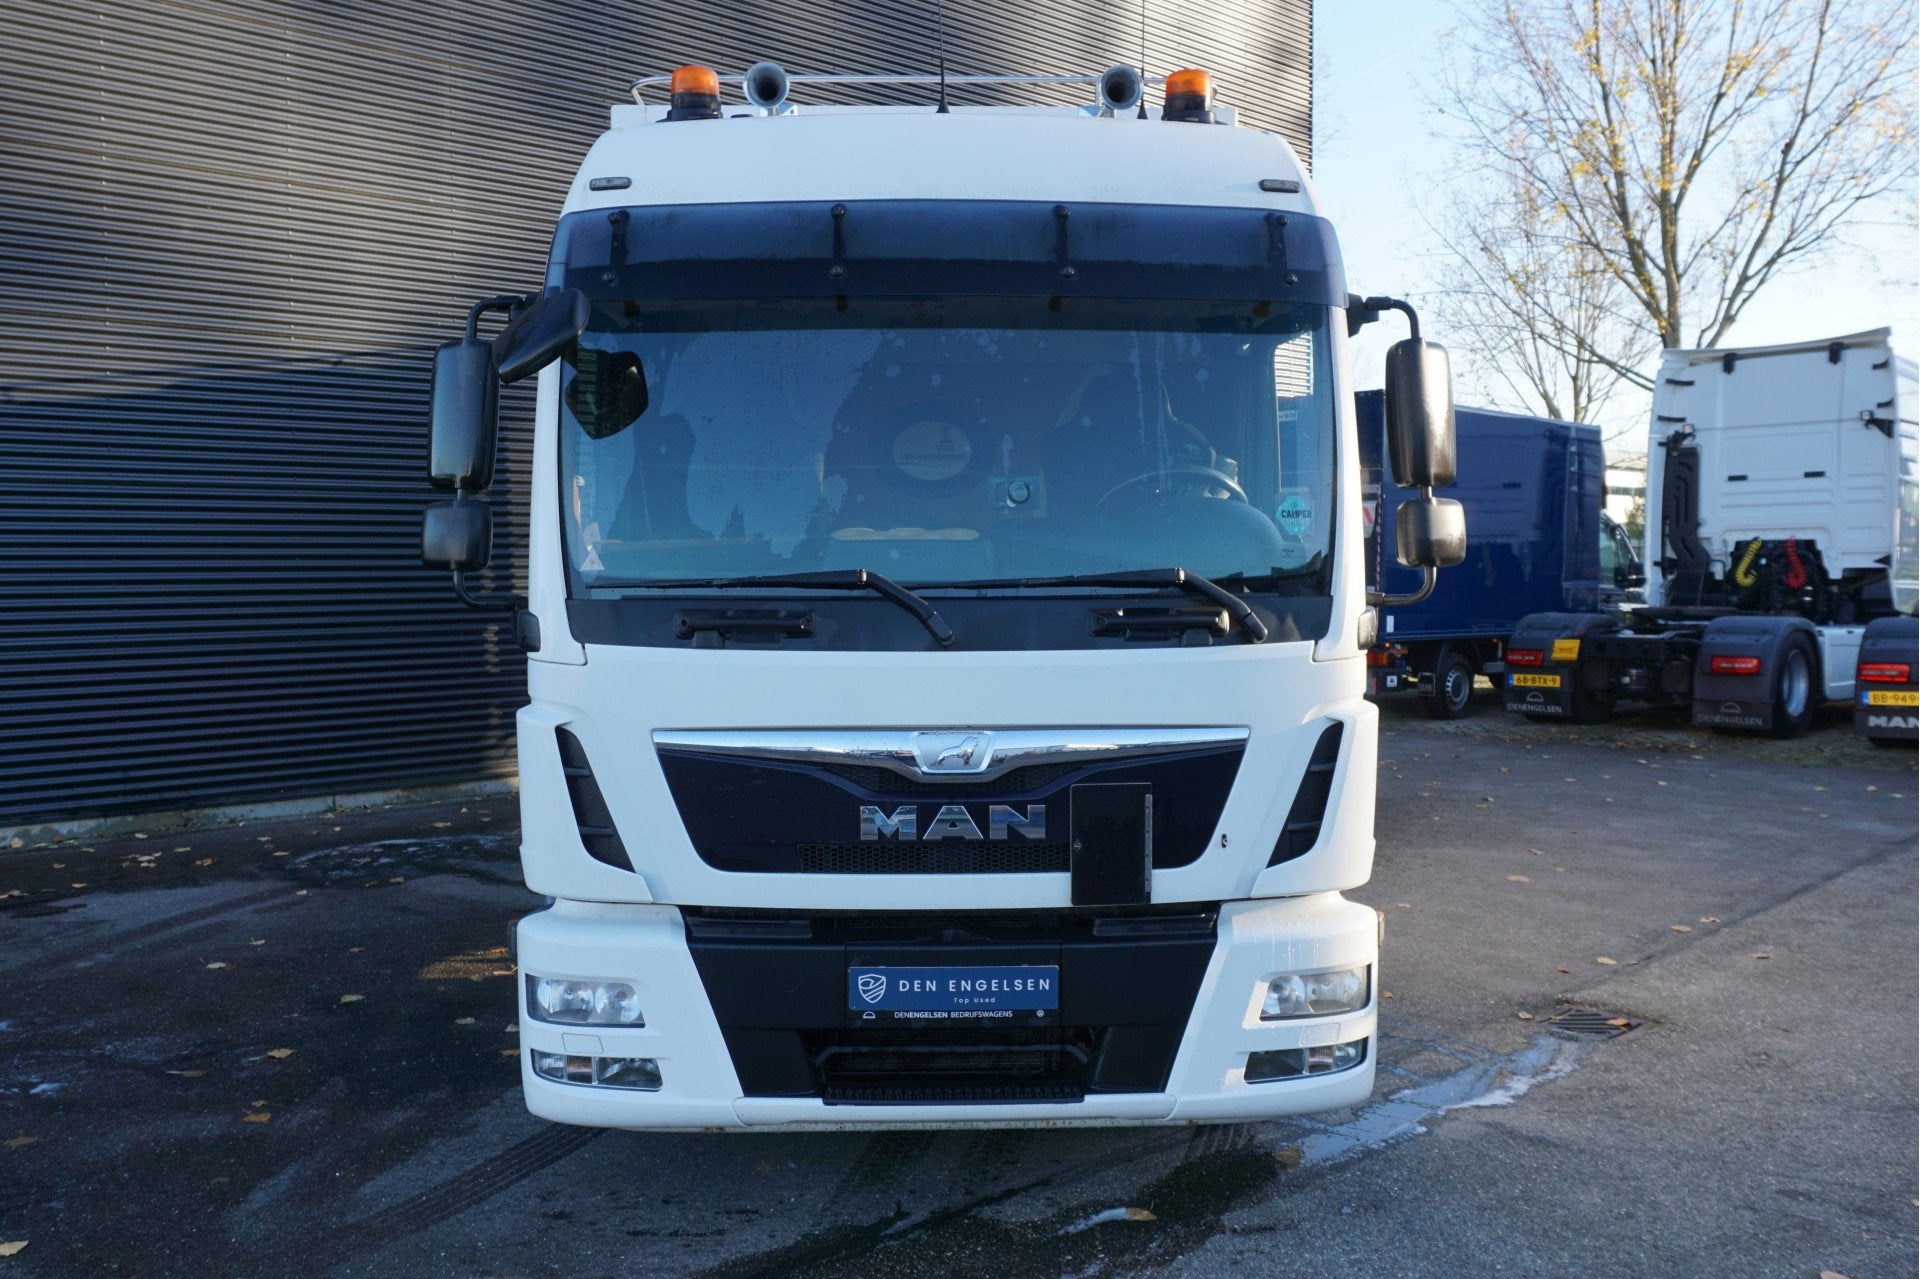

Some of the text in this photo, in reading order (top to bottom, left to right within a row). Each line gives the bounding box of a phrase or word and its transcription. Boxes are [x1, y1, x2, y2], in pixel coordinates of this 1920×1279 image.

[1281, 510, 1312, 519] CAMPER
[1516, 676, 1558, 686] 68-BTX-9
[1868, 715, 1919, 728] MAN
[860, 805, 1046, 840] MAN
[899, 978, 1050, 992] DEN ENGELSEN
[894, 1010, 1013, 1019] DENENGELSEN BEDRIJFSWAGENS
